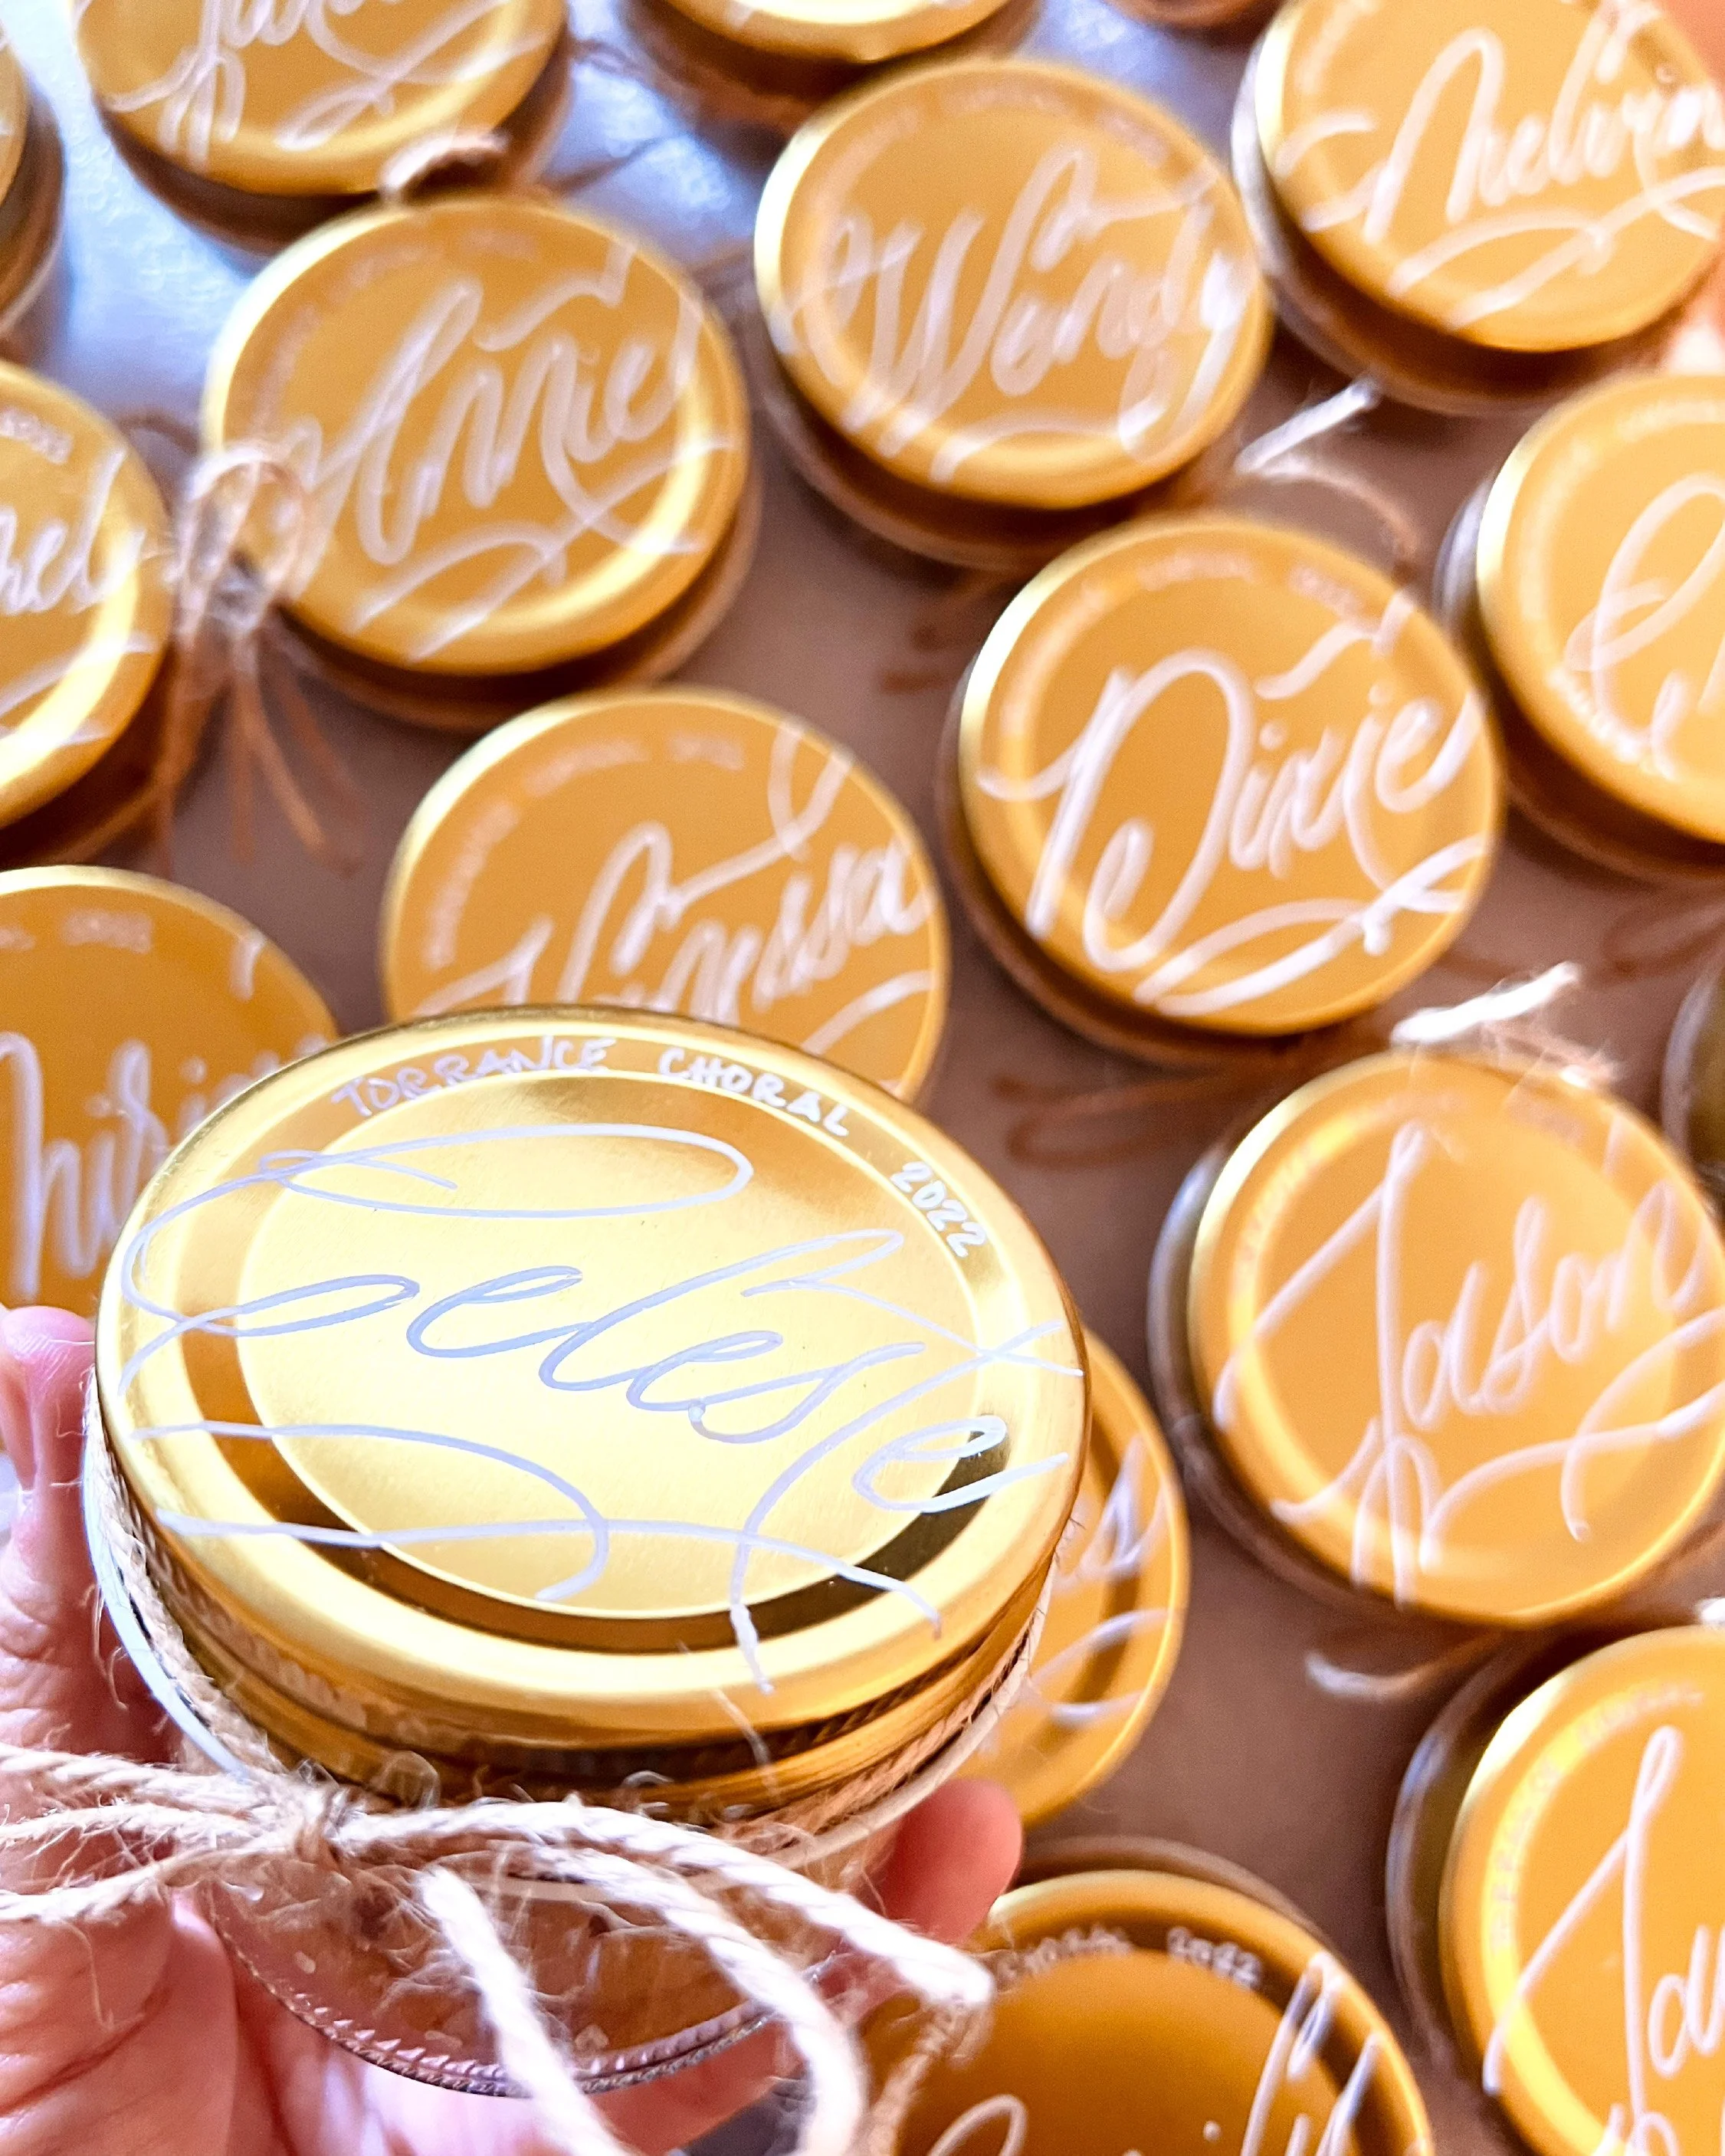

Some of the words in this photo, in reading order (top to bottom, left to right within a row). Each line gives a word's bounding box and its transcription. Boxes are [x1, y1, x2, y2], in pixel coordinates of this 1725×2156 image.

[977, 646, 1483, 972] Dixie
[332, 1035, 617, 1117] TORRANCE
[658, 1048, 850, 1137] CHORAL
[890, 1160, 990, 1258] 2022
[1215, 1119, 1720, 1606] Jason
